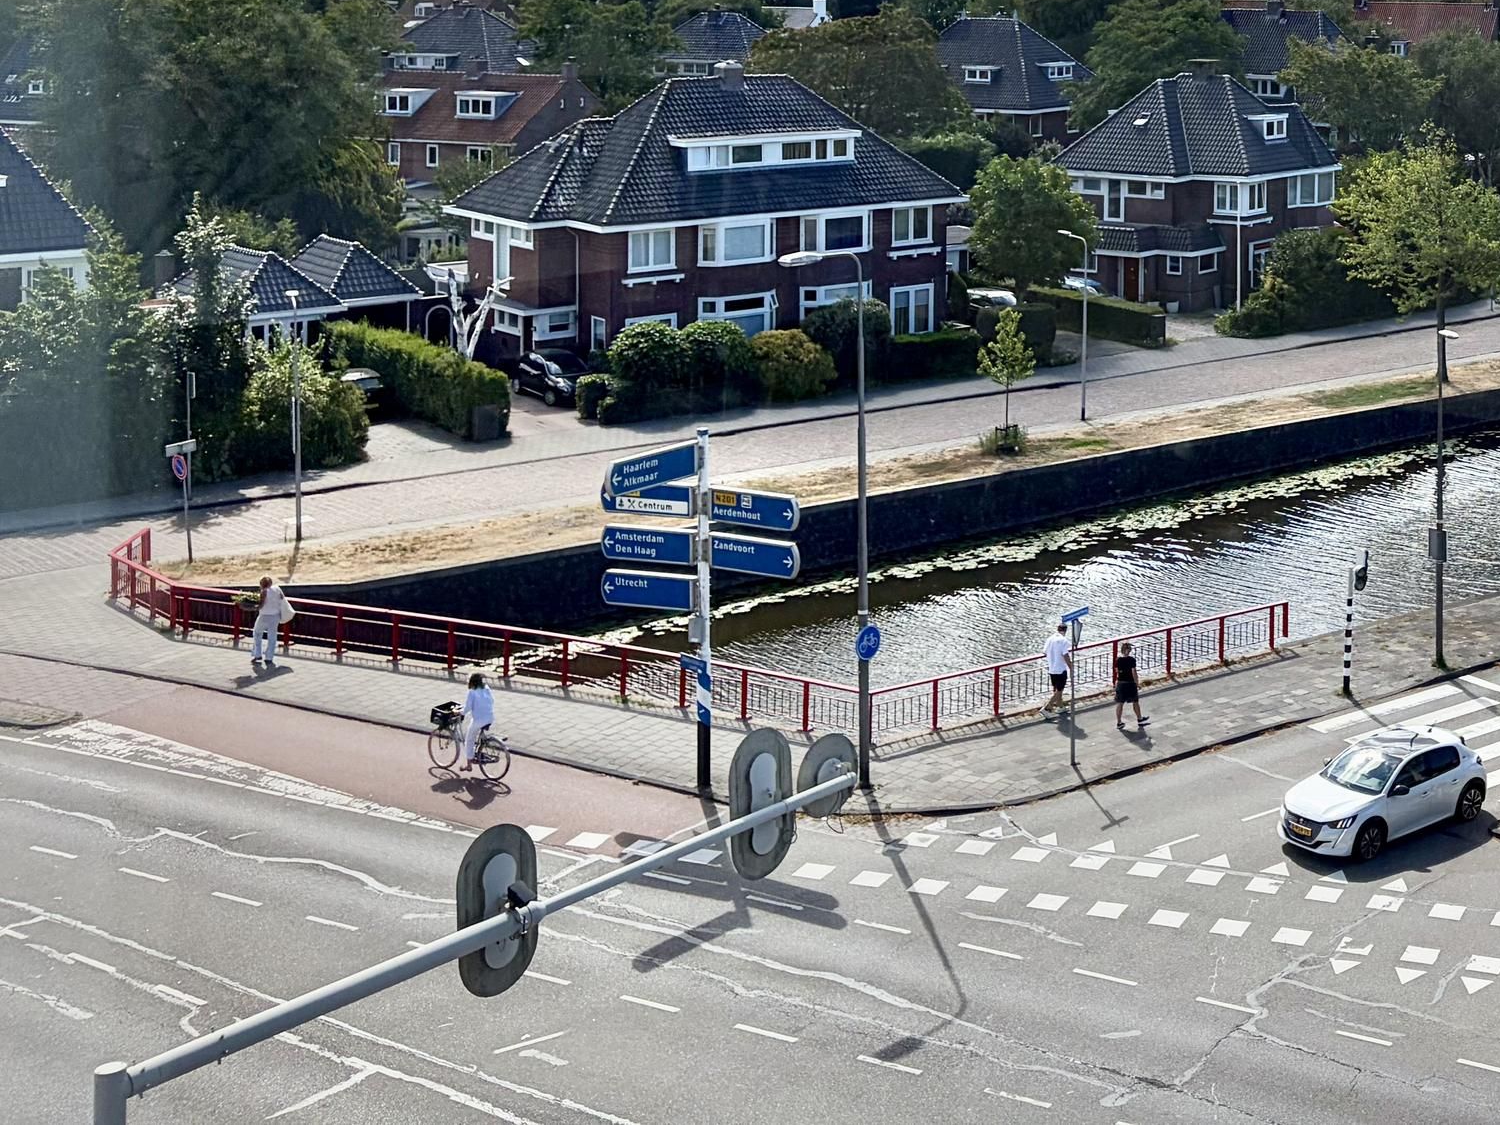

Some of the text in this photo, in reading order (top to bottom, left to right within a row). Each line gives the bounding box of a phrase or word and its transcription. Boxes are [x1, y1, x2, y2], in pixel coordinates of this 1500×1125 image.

[623, 458, 659, 474] Haarlem
[623, 472, 659, 488] Alkmaar
[638, 500, 673, 511] Centrum
[715, 494, 735, 504] N201
[713, 506, 761, 521] Aerdenhout
[615, 531, 665, 544] Amsterdam
[615, 544, 656, 558] Den Haag
[713, 540, 755, 555] Zandvoort
[615, 577, 648, 588] Utrecht
